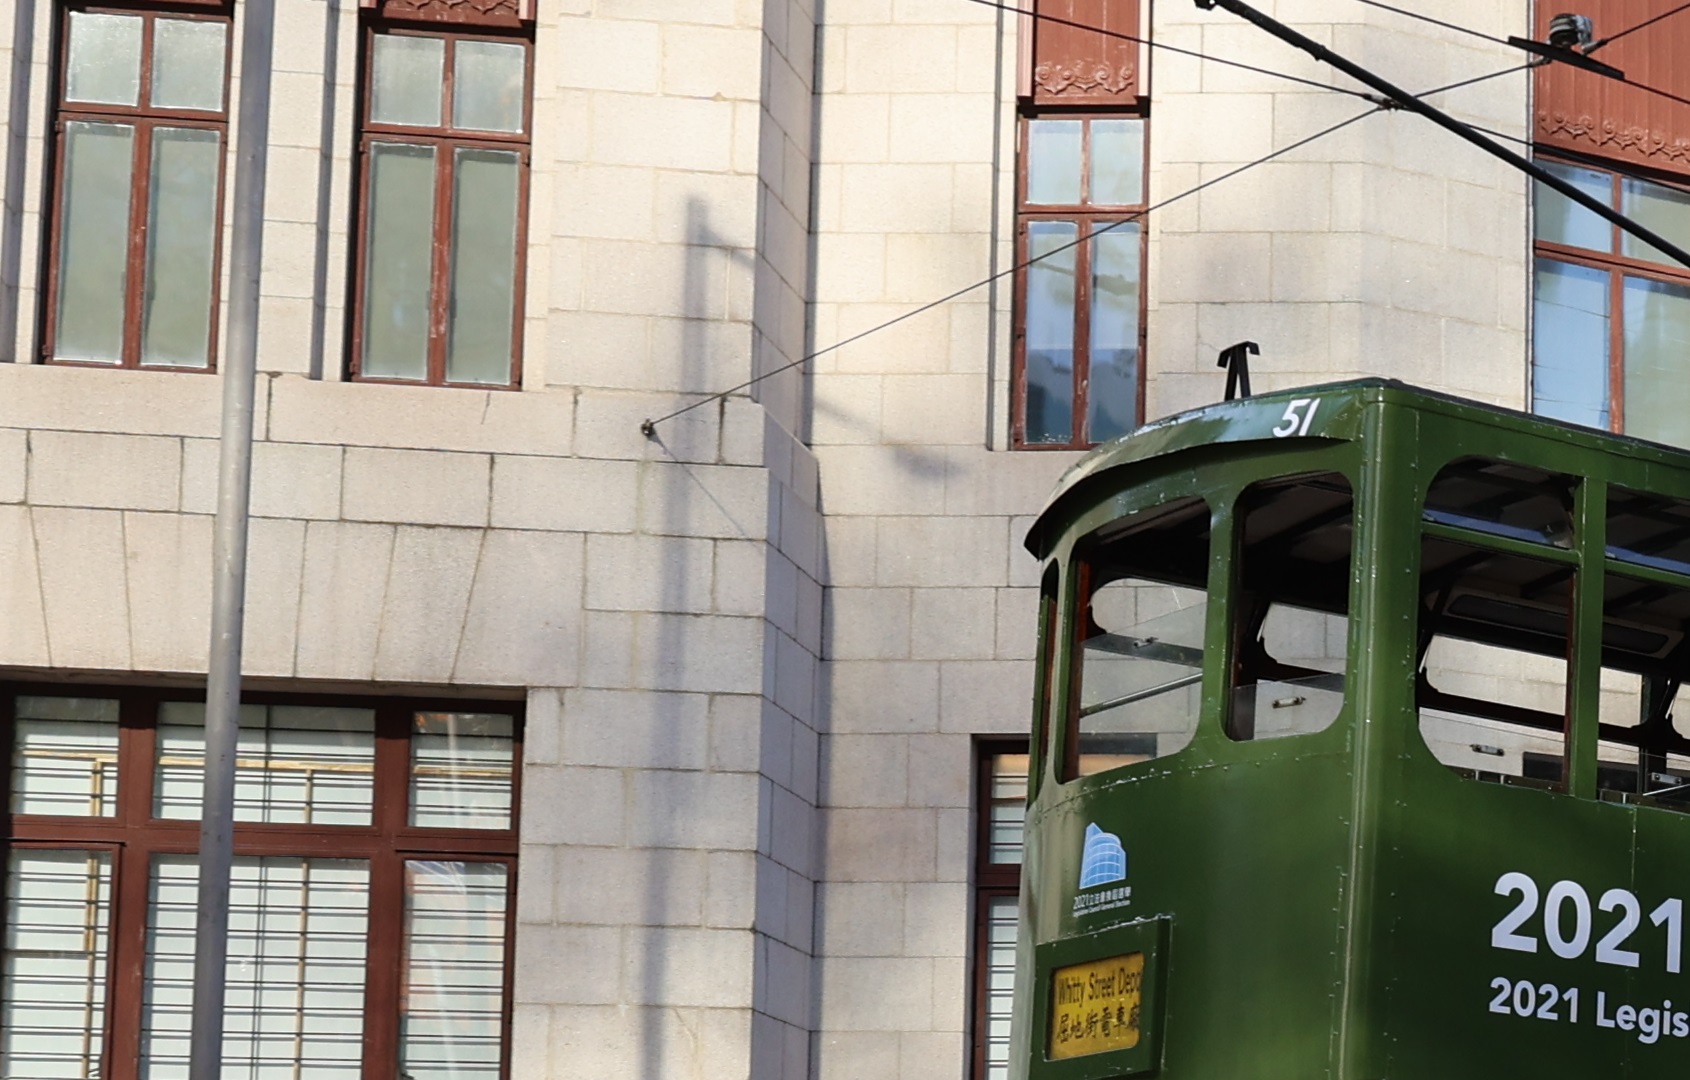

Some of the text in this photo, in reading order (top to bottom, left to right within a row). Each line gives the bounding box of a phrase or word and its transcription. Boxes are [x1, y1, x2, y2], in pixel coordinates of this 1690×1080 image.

[1272, 397, 1321, 438] 51
[1058, 976, 1086, 1008] Whitty
[1088, 970, 1115, 1000] Street
[1489, 976, 1578, 1023] 2021
